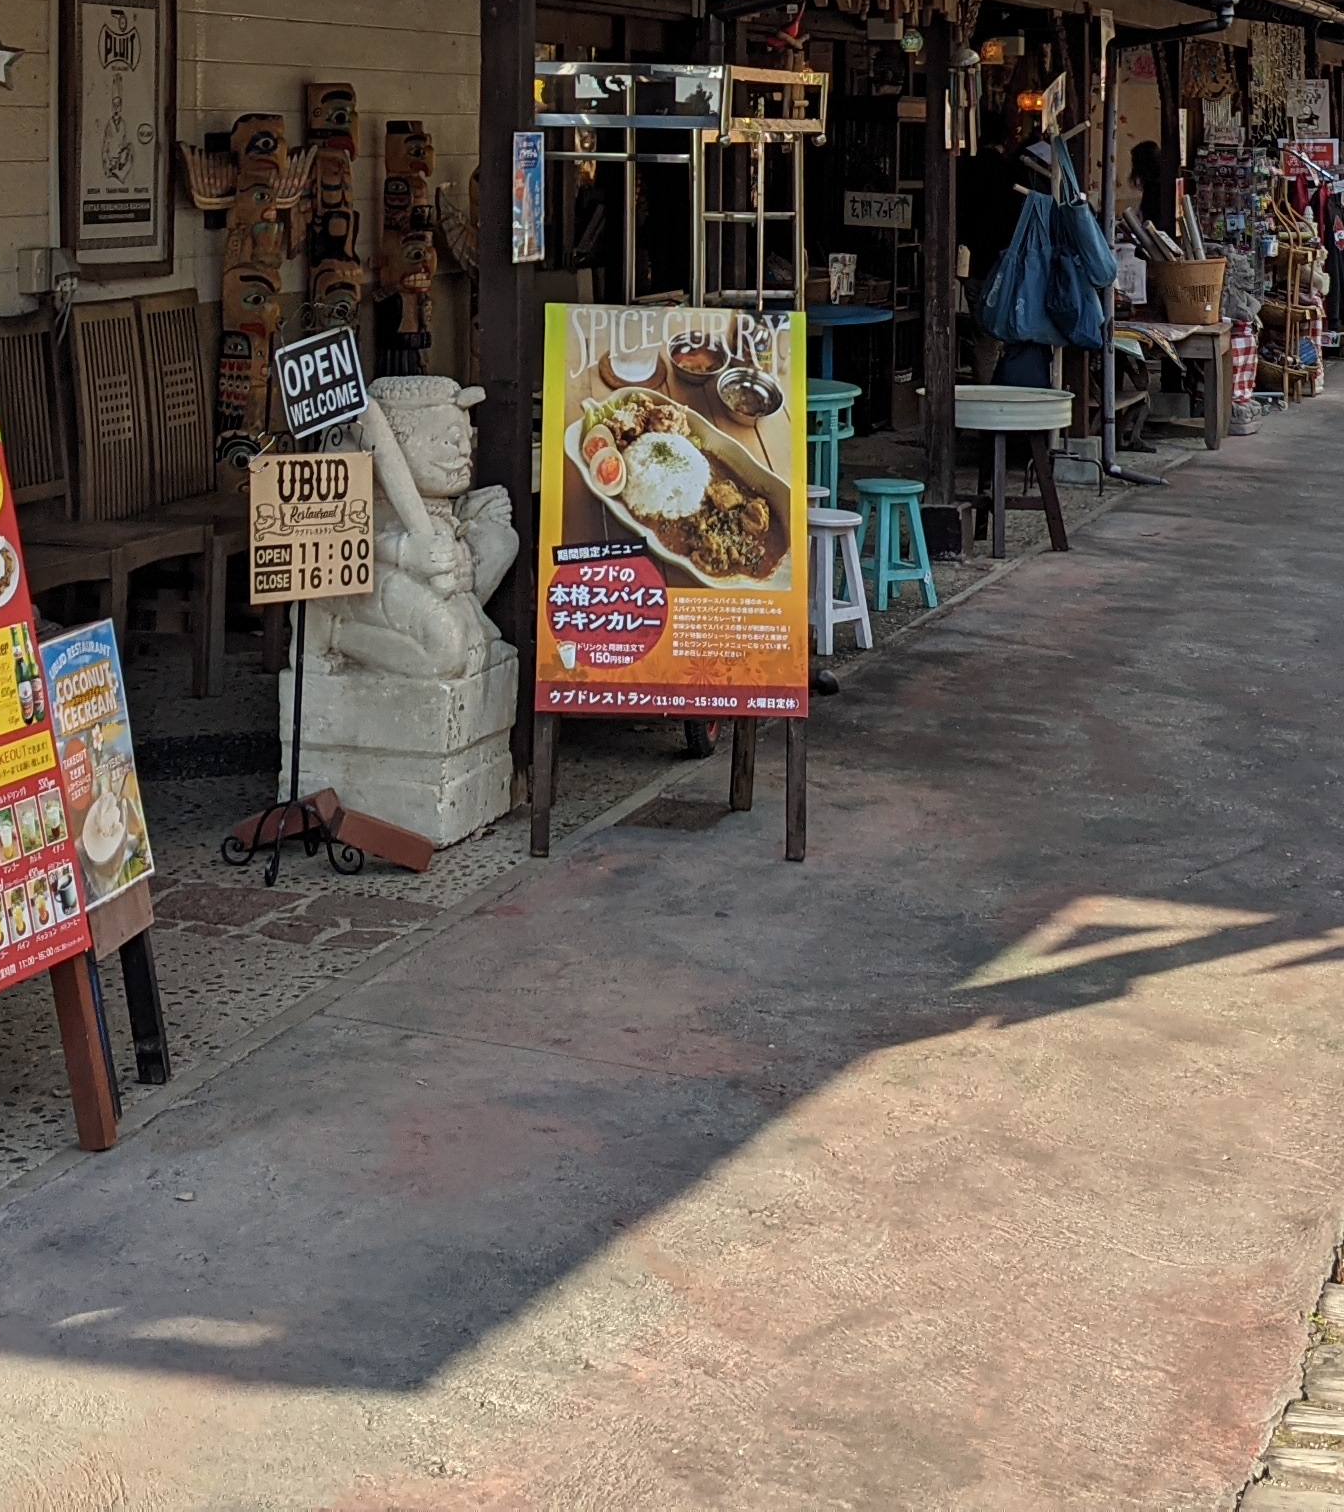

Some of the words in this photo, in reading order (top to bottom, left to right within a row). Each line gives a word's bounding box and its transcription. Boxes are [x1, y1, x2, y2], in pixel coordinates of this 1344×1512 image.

[850, 195, 894, 219] 玄関マット
[283, 338, 355, 398] OPEN
[289, 380, 360, 427] WELCOME
[276, 459, 349, 503] UBUD
[289, 504, 339, 524] Restaurant
[295, 526, 333, 536] ウブドレストラン
[256, 547, 291, 564] OPEN
[298, 538, 370, 564] 11:00
[557, 544, 643, 562] 期間限定メニュー
[256, 571, 291, 590] CLOSE
[298, 563, 370, 589] 16:00
[580, 565, 635, 582] ウブドの
[549, 584, 665, 607] 本格スパイス
[552, 610, 661, 630] チキンカレー
[577, 643, 645, 653] ドリンクと同時注文で
[56, 661, 110, 704] COCONUT
[58, 690, 118, 735] ICECREAM
